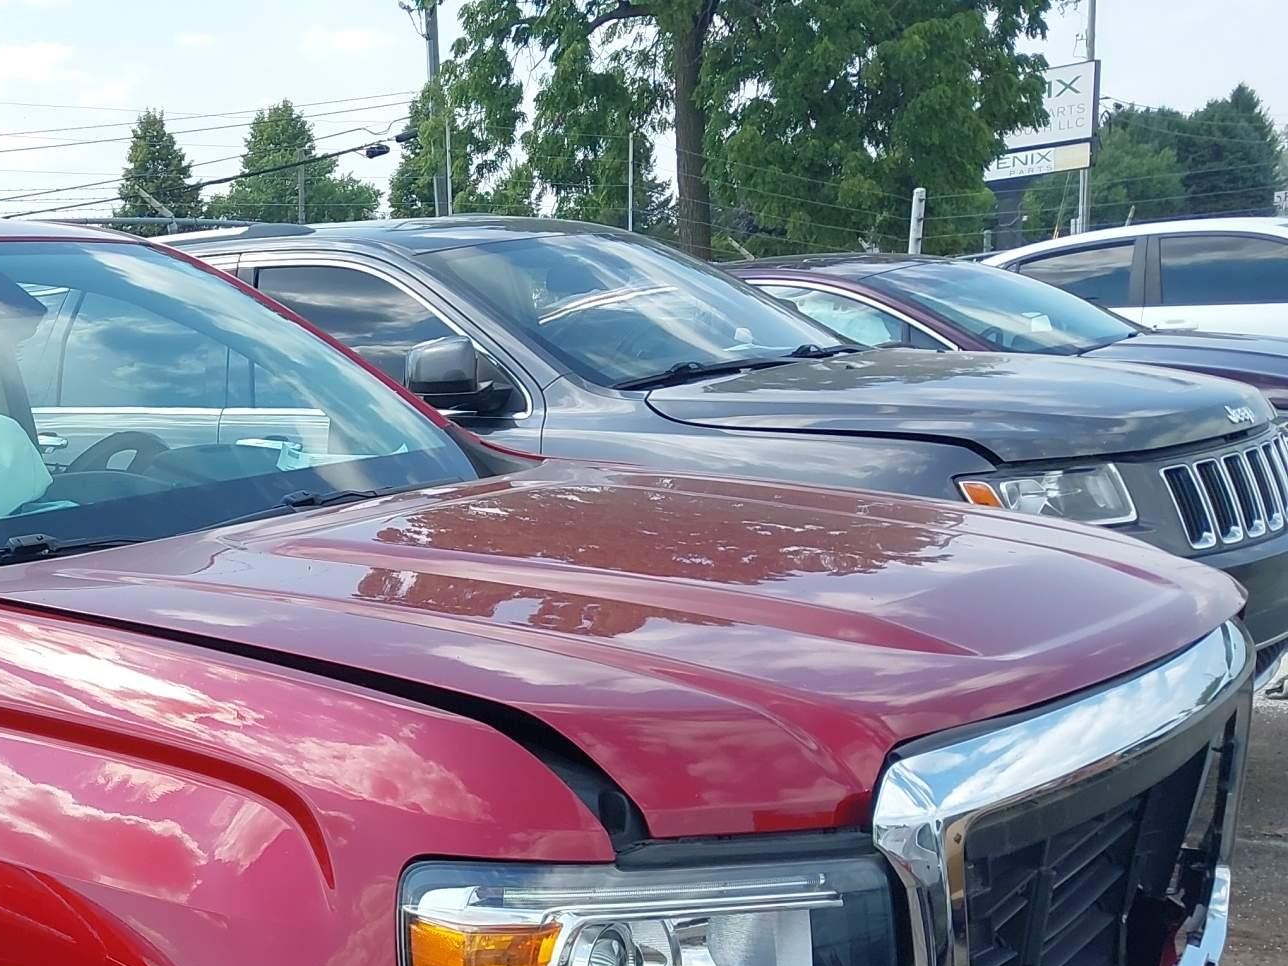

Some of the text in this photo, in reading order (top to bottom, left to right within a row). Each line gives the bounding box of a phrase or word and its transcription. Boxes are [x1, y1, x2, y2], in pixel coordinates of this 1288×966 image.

[1047, 75, 1082, 98] IX
[1048, 103, 1087, 118] ARTS
[1057, 117, 1086, 130] LLC
[996, 150, 1052, 170] ENIX
[1008, 165, 1053, 176] PARTS
